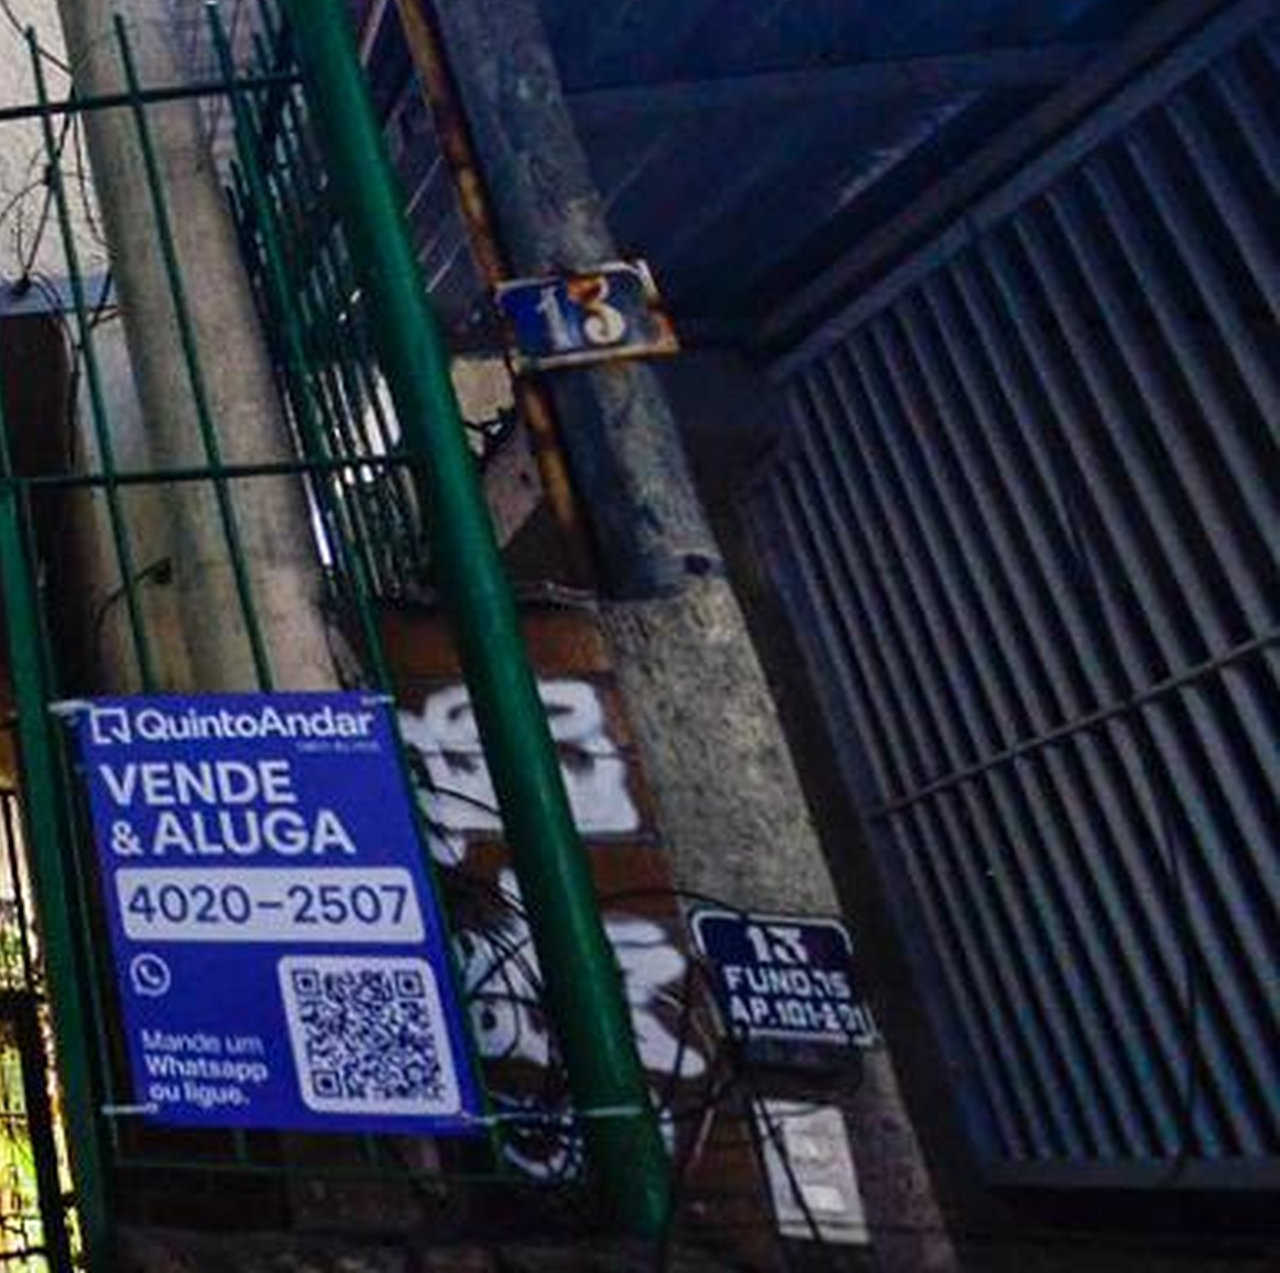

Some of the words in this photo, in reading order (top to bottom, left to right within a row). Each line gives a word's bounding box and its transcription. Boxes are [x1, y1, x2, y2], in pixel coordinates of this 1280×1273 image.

[135, 706, 374, 741] QuintoAndar
[98, 759, 297, 806] VENDE
[111, 821, 144, 856] &
[152, 809, 357, 856] ALUGA
[128, 884, 408, 925] 4020-2507
[142, 1029, 222, 1054] Mande
[225, 1034, 265, 1055] um
[144, 1054, 269, 1083] Whatsapp
[149, 1083, 181, 1102] ou
[183, 1081, 251, 1108] ligue.
